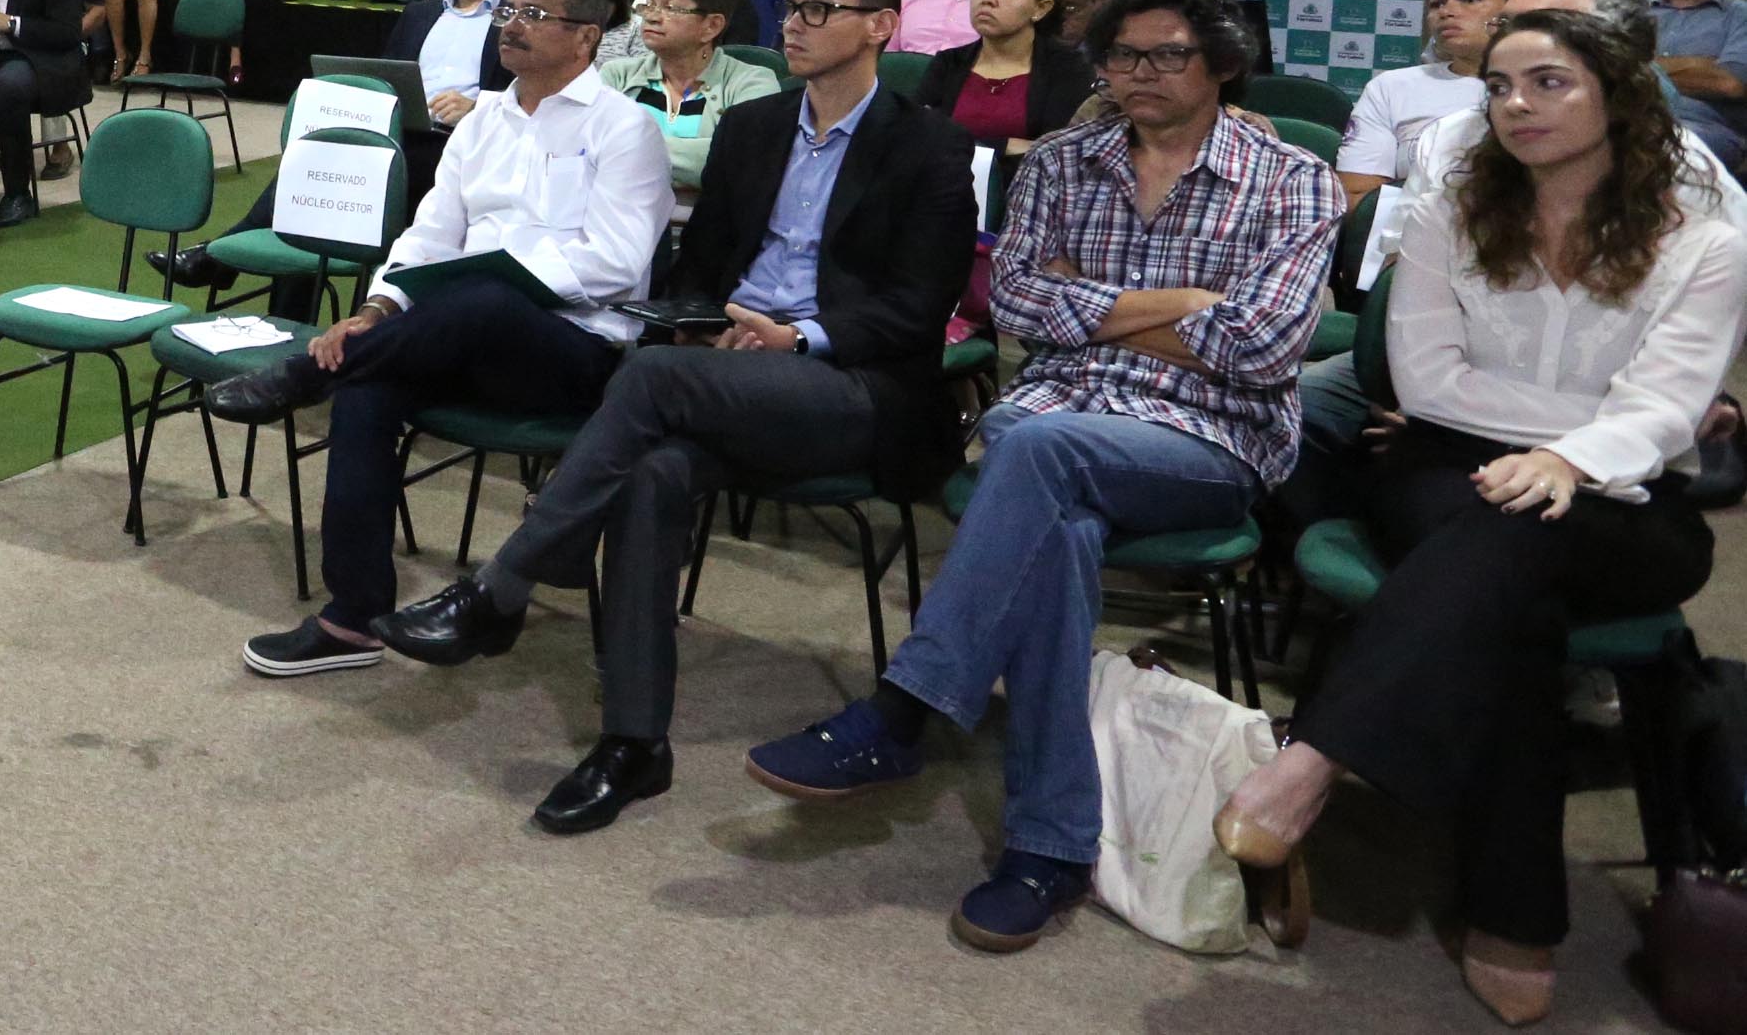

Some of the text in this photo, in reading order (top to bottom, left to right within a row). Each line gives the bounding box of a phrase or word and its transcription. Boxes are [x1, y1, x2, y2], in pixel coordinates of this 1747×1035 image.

[320, 106, 372, 123] RESERVADO
[307, 170, 367, 186] RESERVADO
[291, 194, 373, 214] NÚCLEO GESTOR
